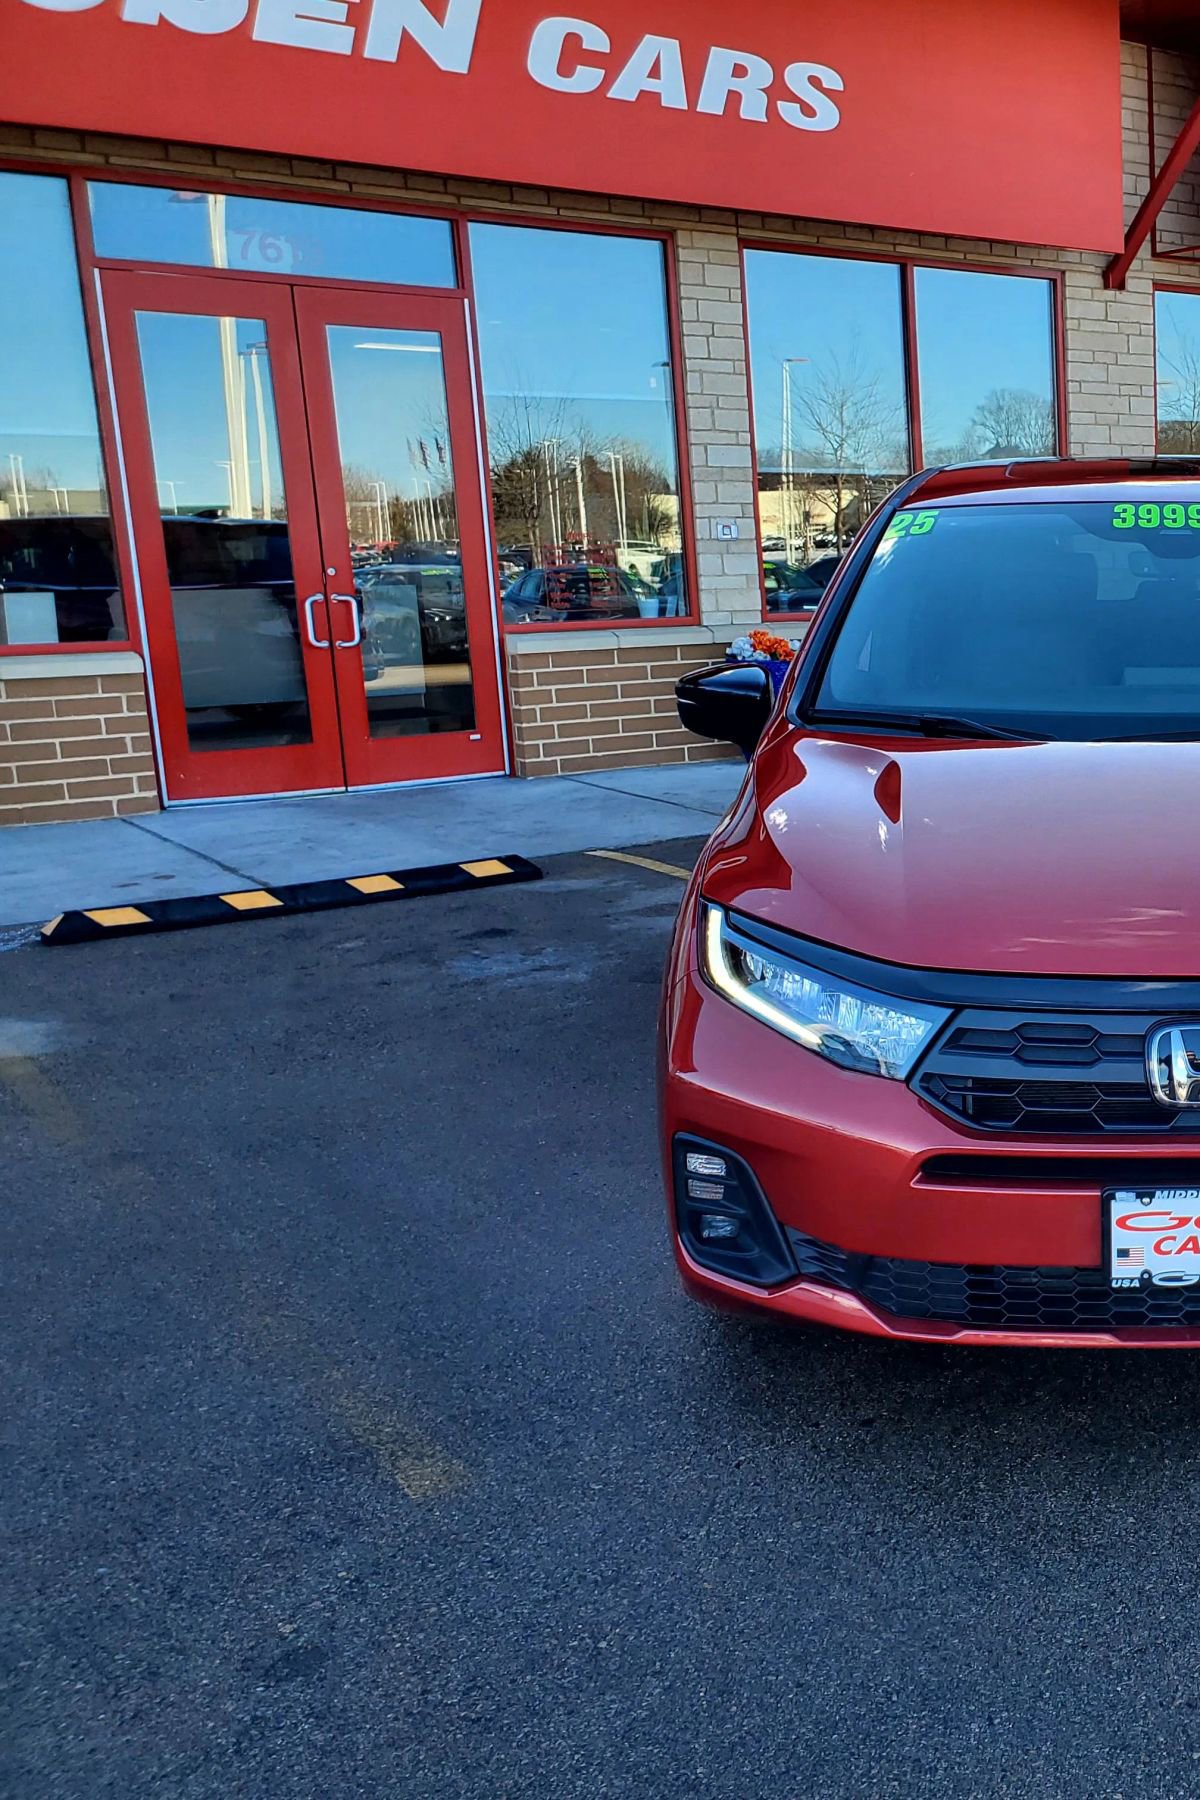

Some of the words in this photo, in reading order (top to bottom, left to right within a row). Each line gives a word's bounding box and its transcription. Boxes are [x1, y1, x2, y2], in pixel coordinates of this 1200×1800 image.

[527, 16, 845, 131] CARS
[883, 510, 940, 539] 25
[1111, 1278, 1140, 1288] USA
